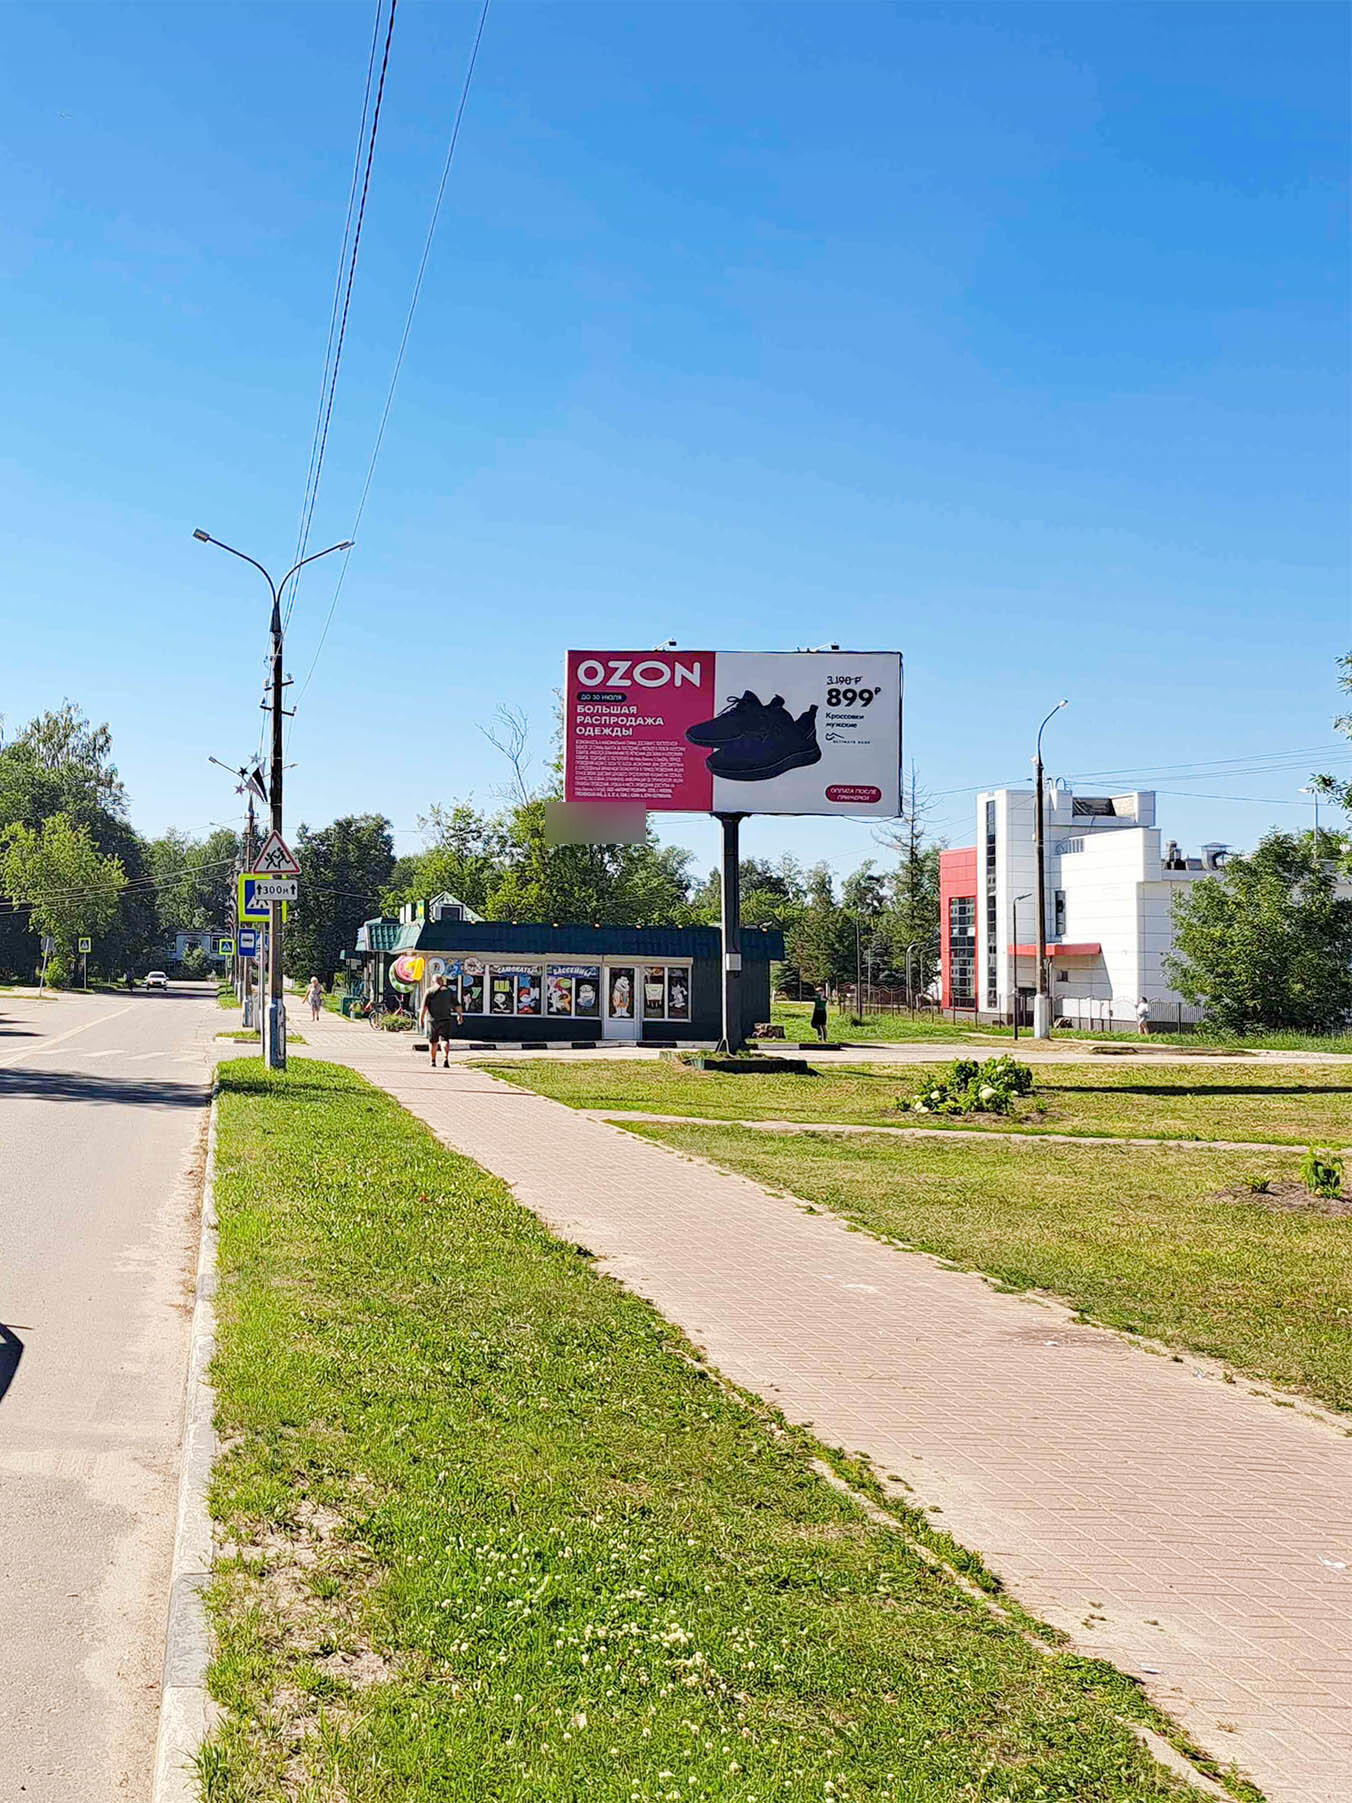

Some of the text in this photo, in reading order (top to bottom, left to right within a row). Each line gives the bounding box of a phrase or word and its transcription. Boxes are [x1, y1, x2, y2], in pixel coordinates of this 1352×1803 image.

[577, 660, 701, 688] OZON
[576, 705, 637, 714] БОЛЬШАЯ
[576, 716, 664, 725] РАСПРОДАЖА
[576, 726, 633, 736] ОДЕЖДЫ
